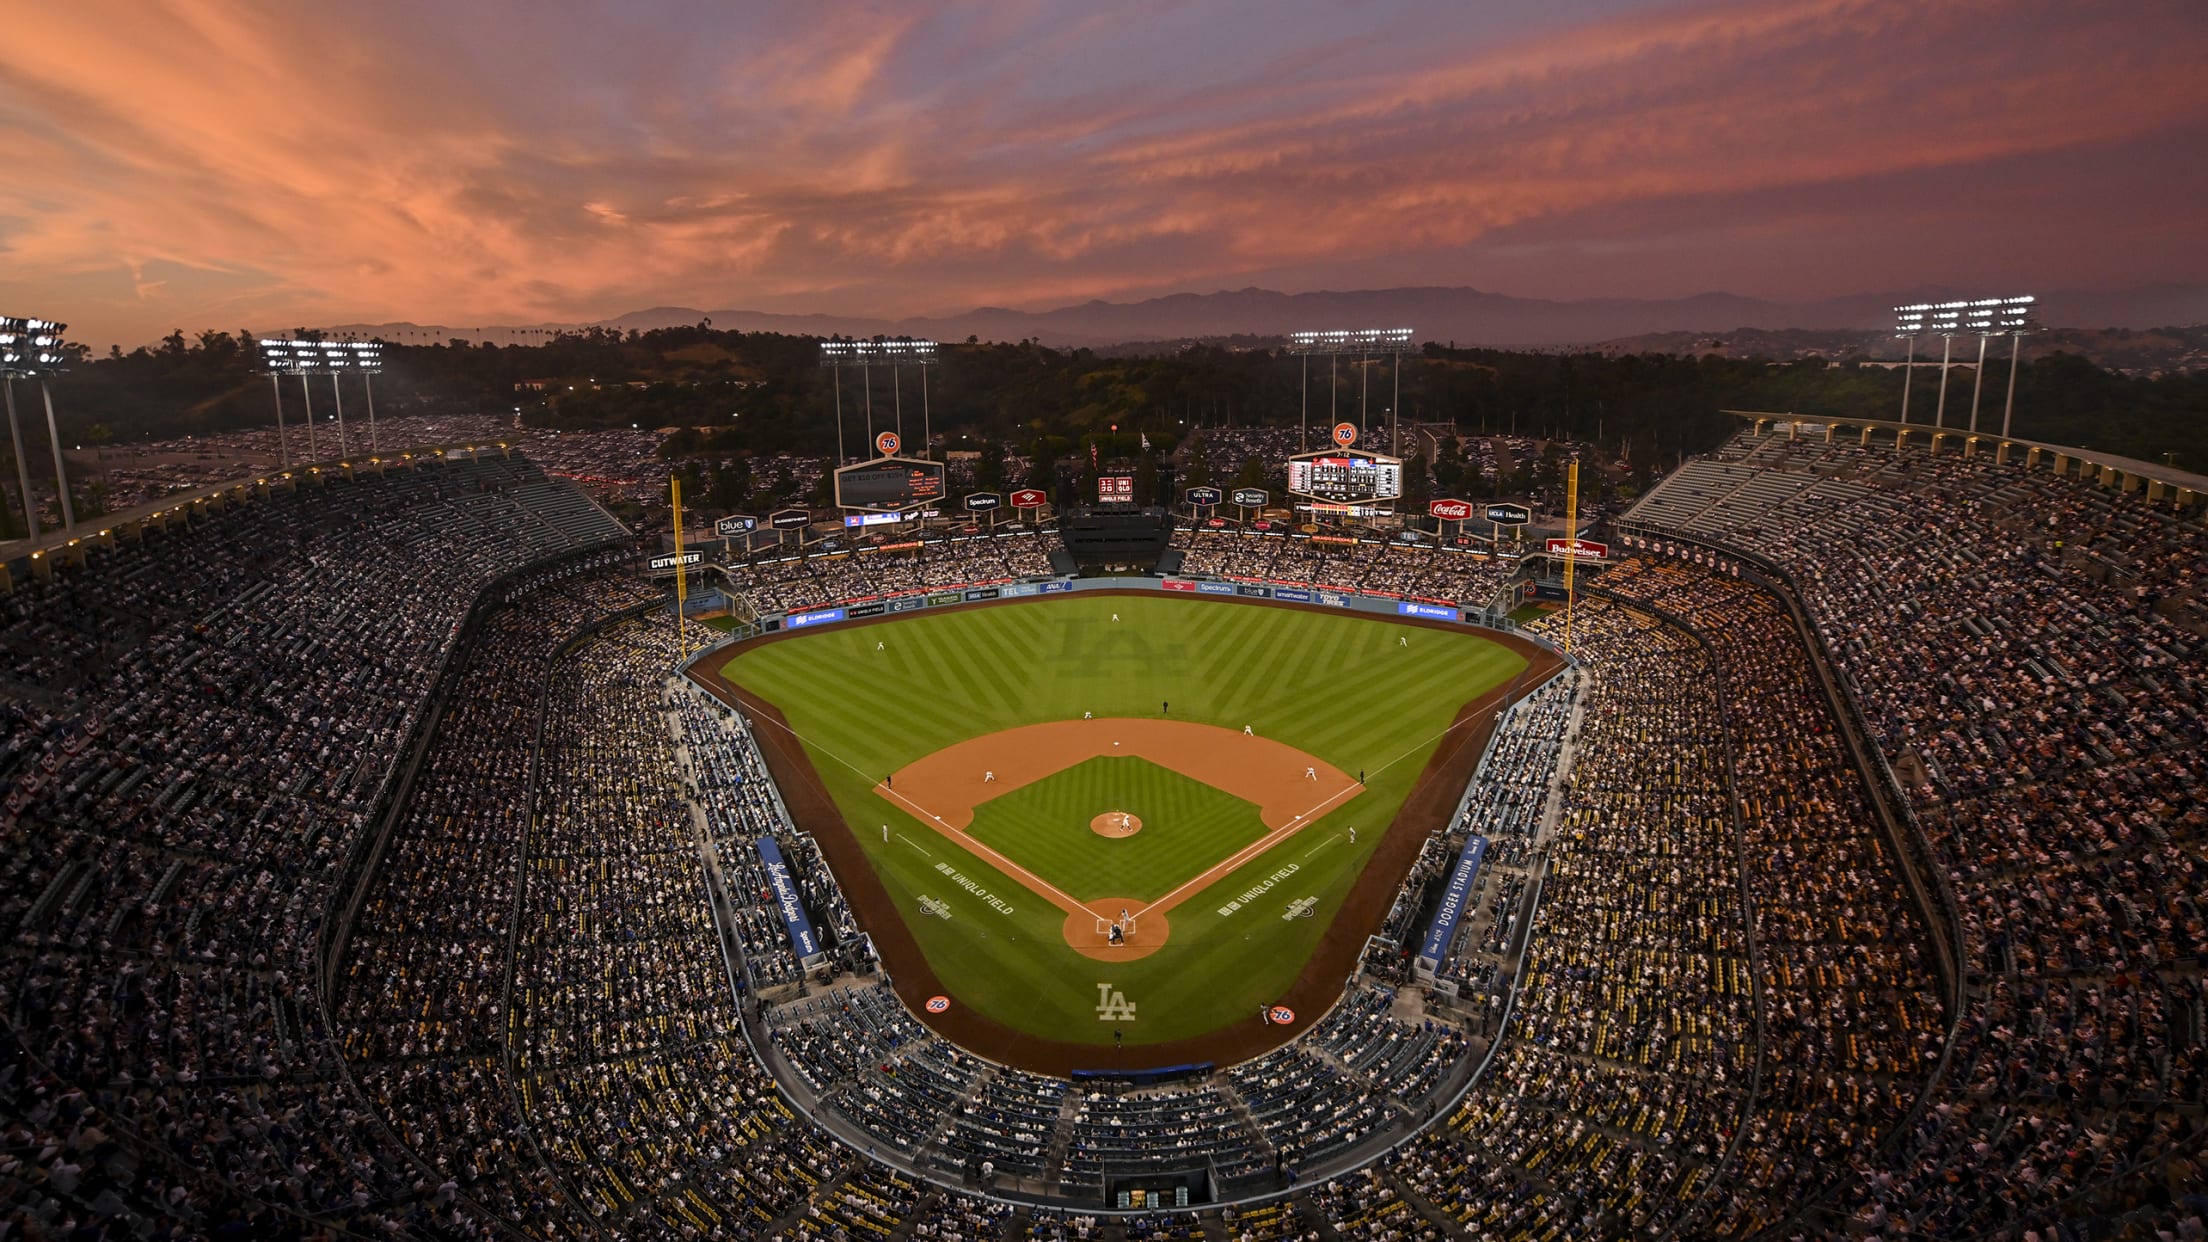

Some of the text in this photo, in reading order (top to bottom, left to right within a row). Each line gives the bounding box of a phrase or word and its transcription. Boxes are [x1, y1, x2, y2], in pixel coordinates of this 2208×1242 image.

[1337, 427, 1352, 440] 76
[882, 437, 897, 450] 76
[969, 498, 996, 506] Spectrum
[1505, 511, 1526, 520] Health
[720, 520, 744, 531] blue
[1552, 543, 1601, 557] Budweiser
[651, 554, 700, 568] CUTWATER
[1201, 583, 1231, 592] Spectrum
[808, 612, 836, 621] ELDRIDGE
[1419, 607, 1448, 616] ELDRIDGE
[1237, 863, 1300, 904] UNIQLO FIELD
[952, 873, 1014, 915] UNIQLO FIELD
[1438, 859, 1473, 926] DODGER STADIUM
[781, 893, 800, 923] Dodgers
[926, 999, 949, 1010] 76
[1096, 983, 1137, 1021] LA
